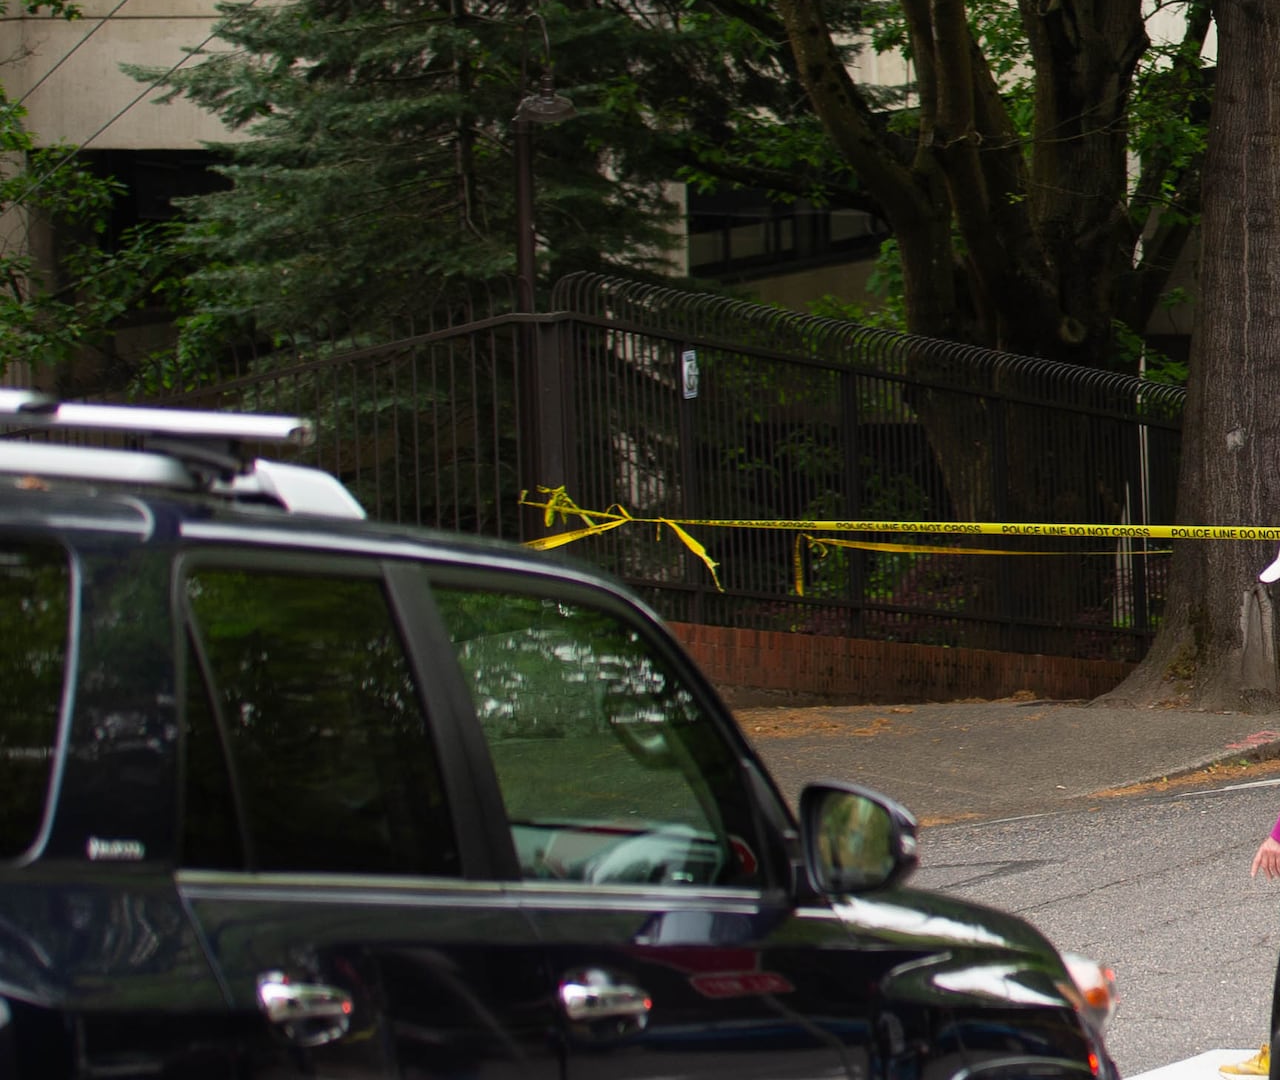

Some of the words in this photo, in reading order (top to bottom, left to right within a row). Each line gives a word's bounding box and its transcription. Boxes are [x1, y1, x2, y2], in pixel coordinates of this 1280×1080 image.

[1002, 526, 1041, 535] POLICE
[1043, 527, 1066, 535] LINE
[1069, 527, 1085, 536] DO
[1087, 527, 1110, 536] NOT
[1112, 528, 1150, 537] CROSS
[1172, 529, 1210, 538] POLICE
[1213, 530, 1237, 538] LINE
[1240, 530, 1255, 539] DO
[1258, 530, 1280, 539] NOT
